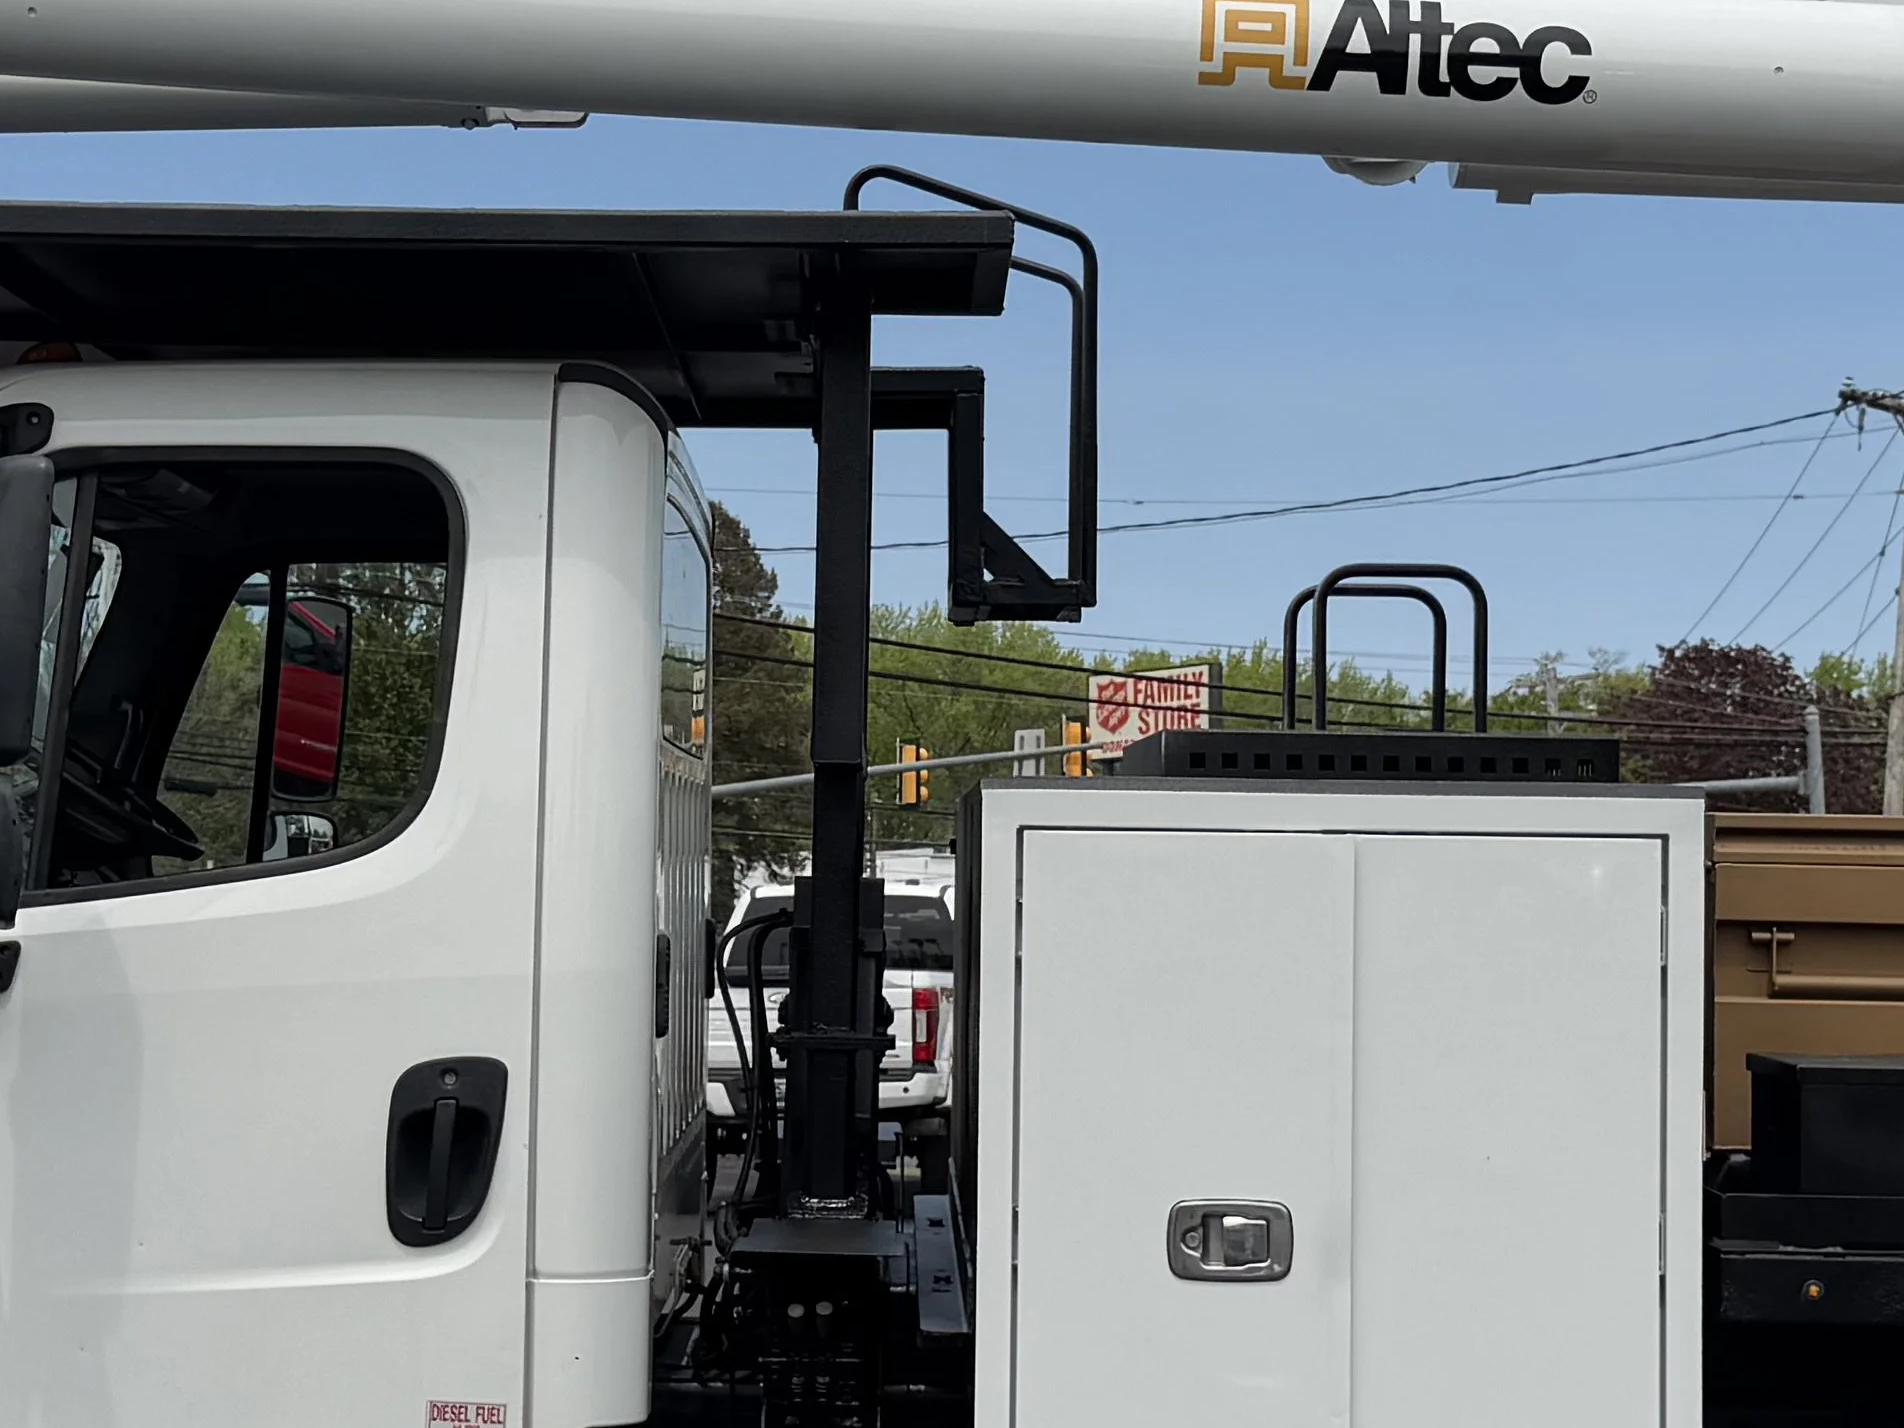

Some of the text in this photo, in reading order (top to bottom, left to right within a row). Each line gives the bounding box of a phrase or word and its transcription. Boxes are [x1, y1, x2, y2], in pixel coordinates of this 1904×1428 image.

[1133, 670, 1204, 704] FAMILY
[431, 1404, 504, 1424] DIESEL FUEL
